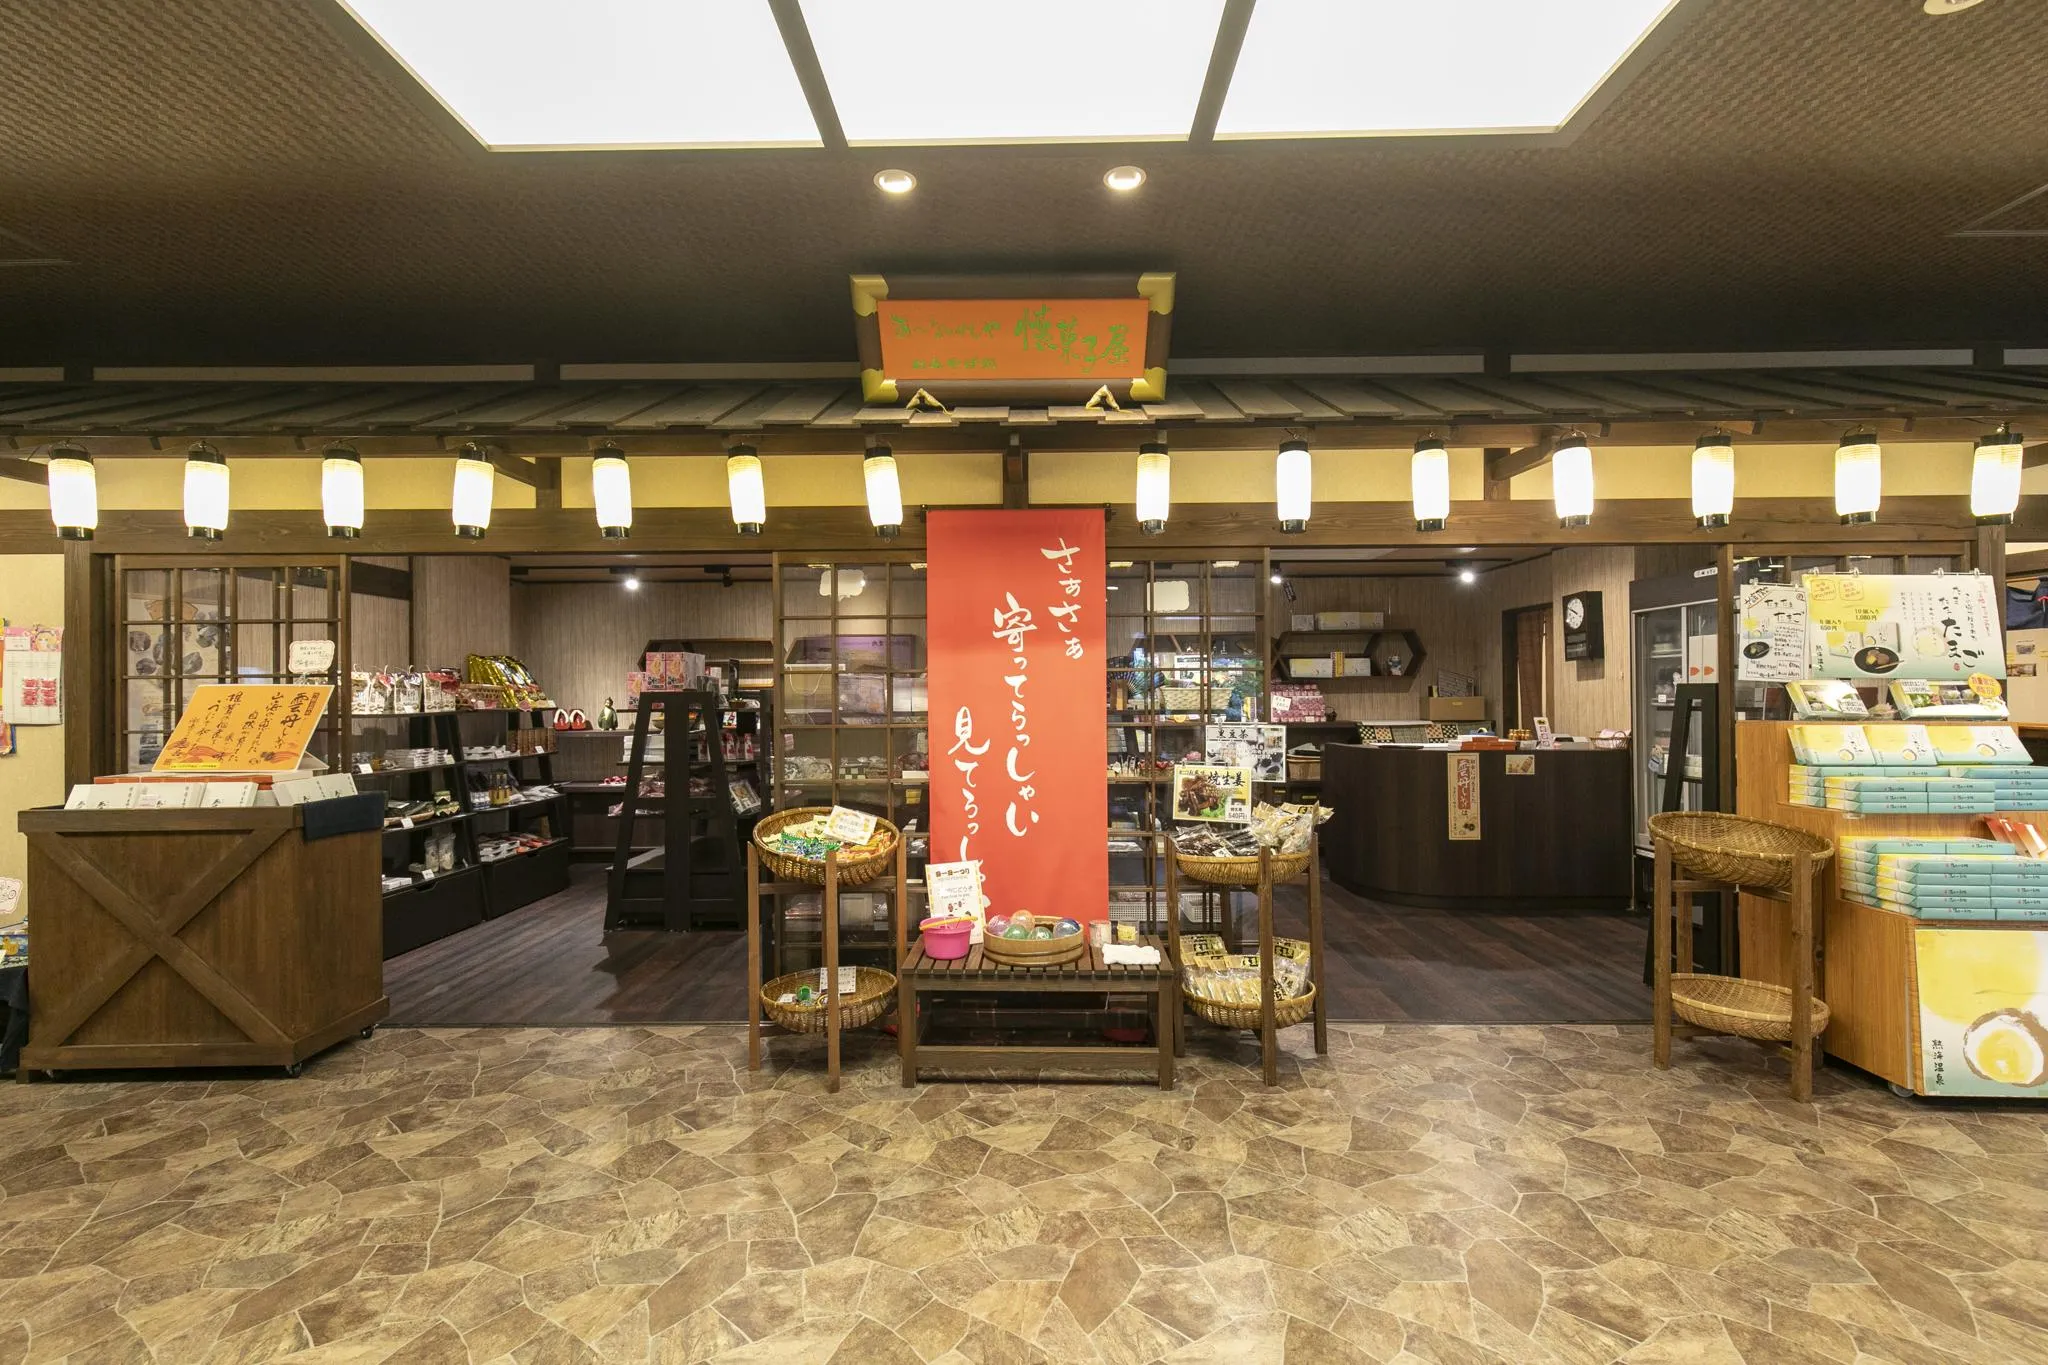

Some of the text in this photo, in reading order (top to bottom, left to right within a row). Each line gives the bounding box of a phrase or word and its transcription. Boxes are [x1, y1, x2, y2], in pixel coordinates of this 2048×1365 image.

[1041, 537, 1083, 659] さぁさぁ
[992, 591, 1039, 837] 寄ってらっしゃい
[1217, 729, 1249, 739] 黒豆茶
[947, 706, 991, 908] 見てらっし
[1208, 771, 1246, 787] 焼生姜
[1932, 1039, 1945, 1086] 熱海温泉
